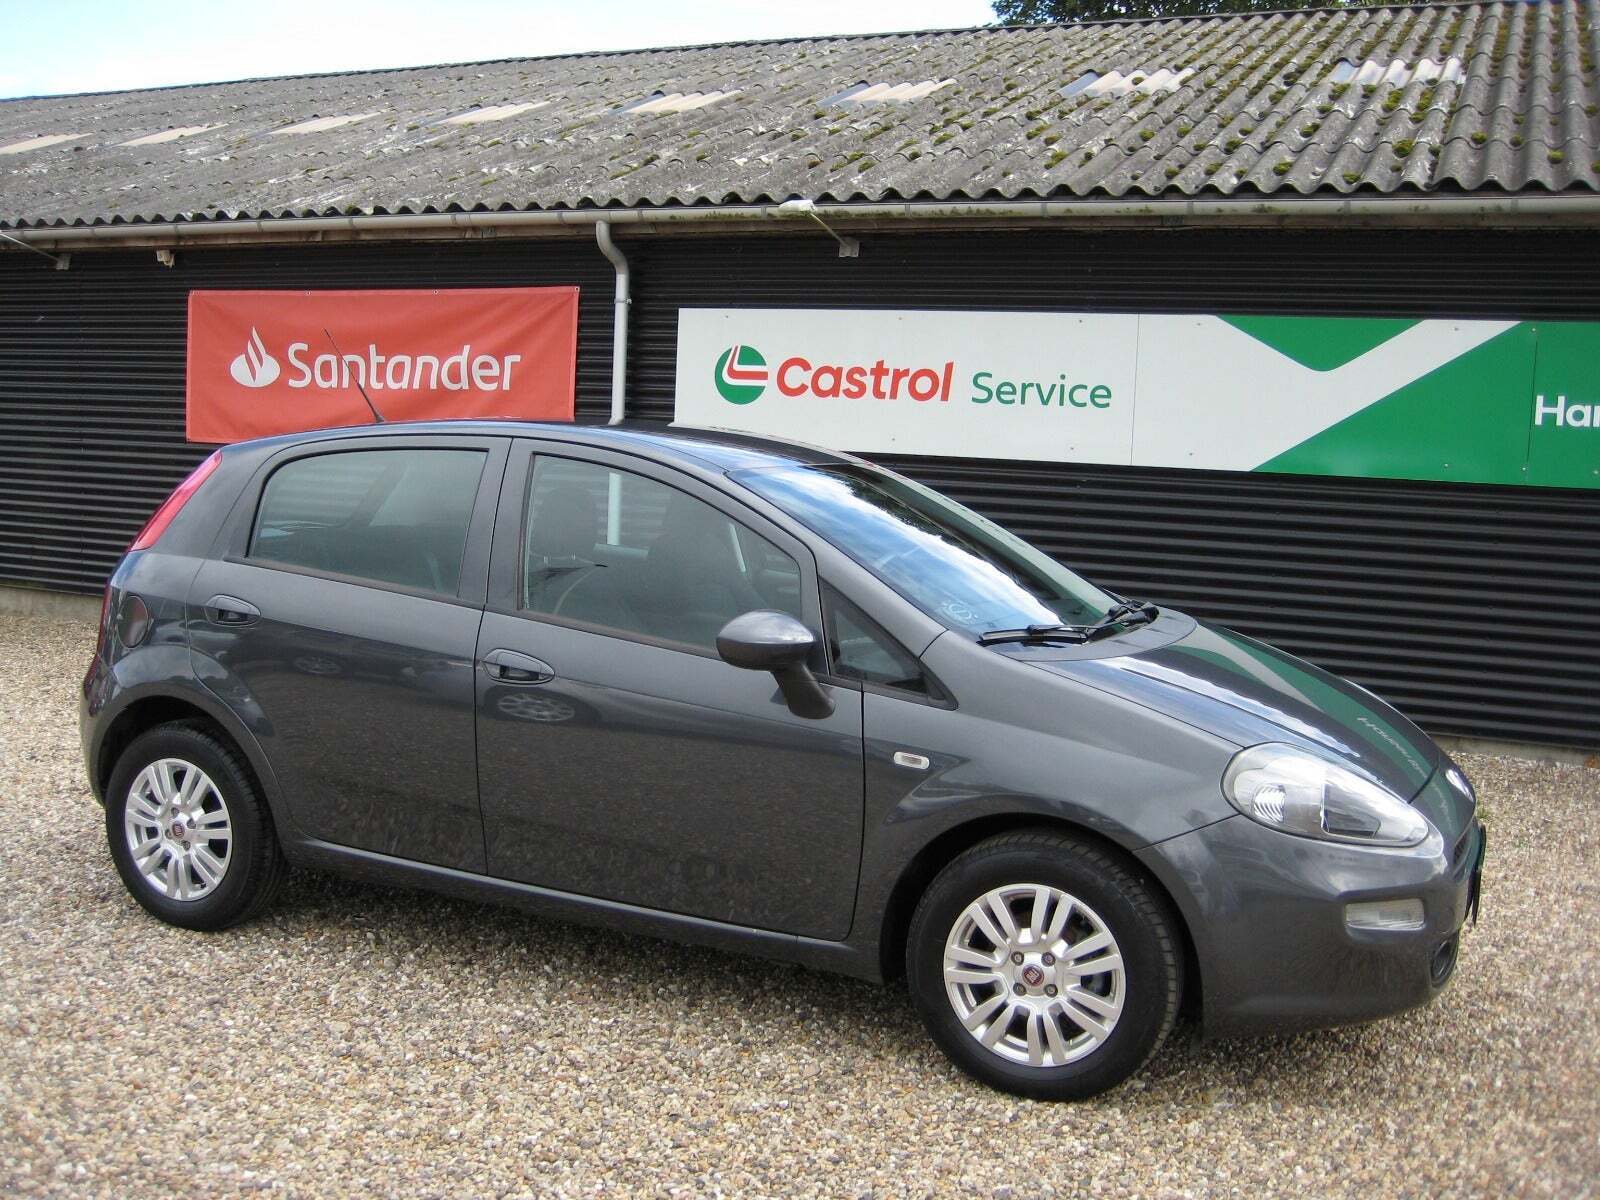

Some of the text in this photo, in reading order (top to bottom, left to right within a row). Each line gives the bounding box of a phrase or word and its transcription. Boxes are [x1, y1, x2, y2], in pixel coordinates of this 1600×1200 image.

[287, 342, 521, 391] Santander
[776, 357, 1113, 409] Castrol Service
